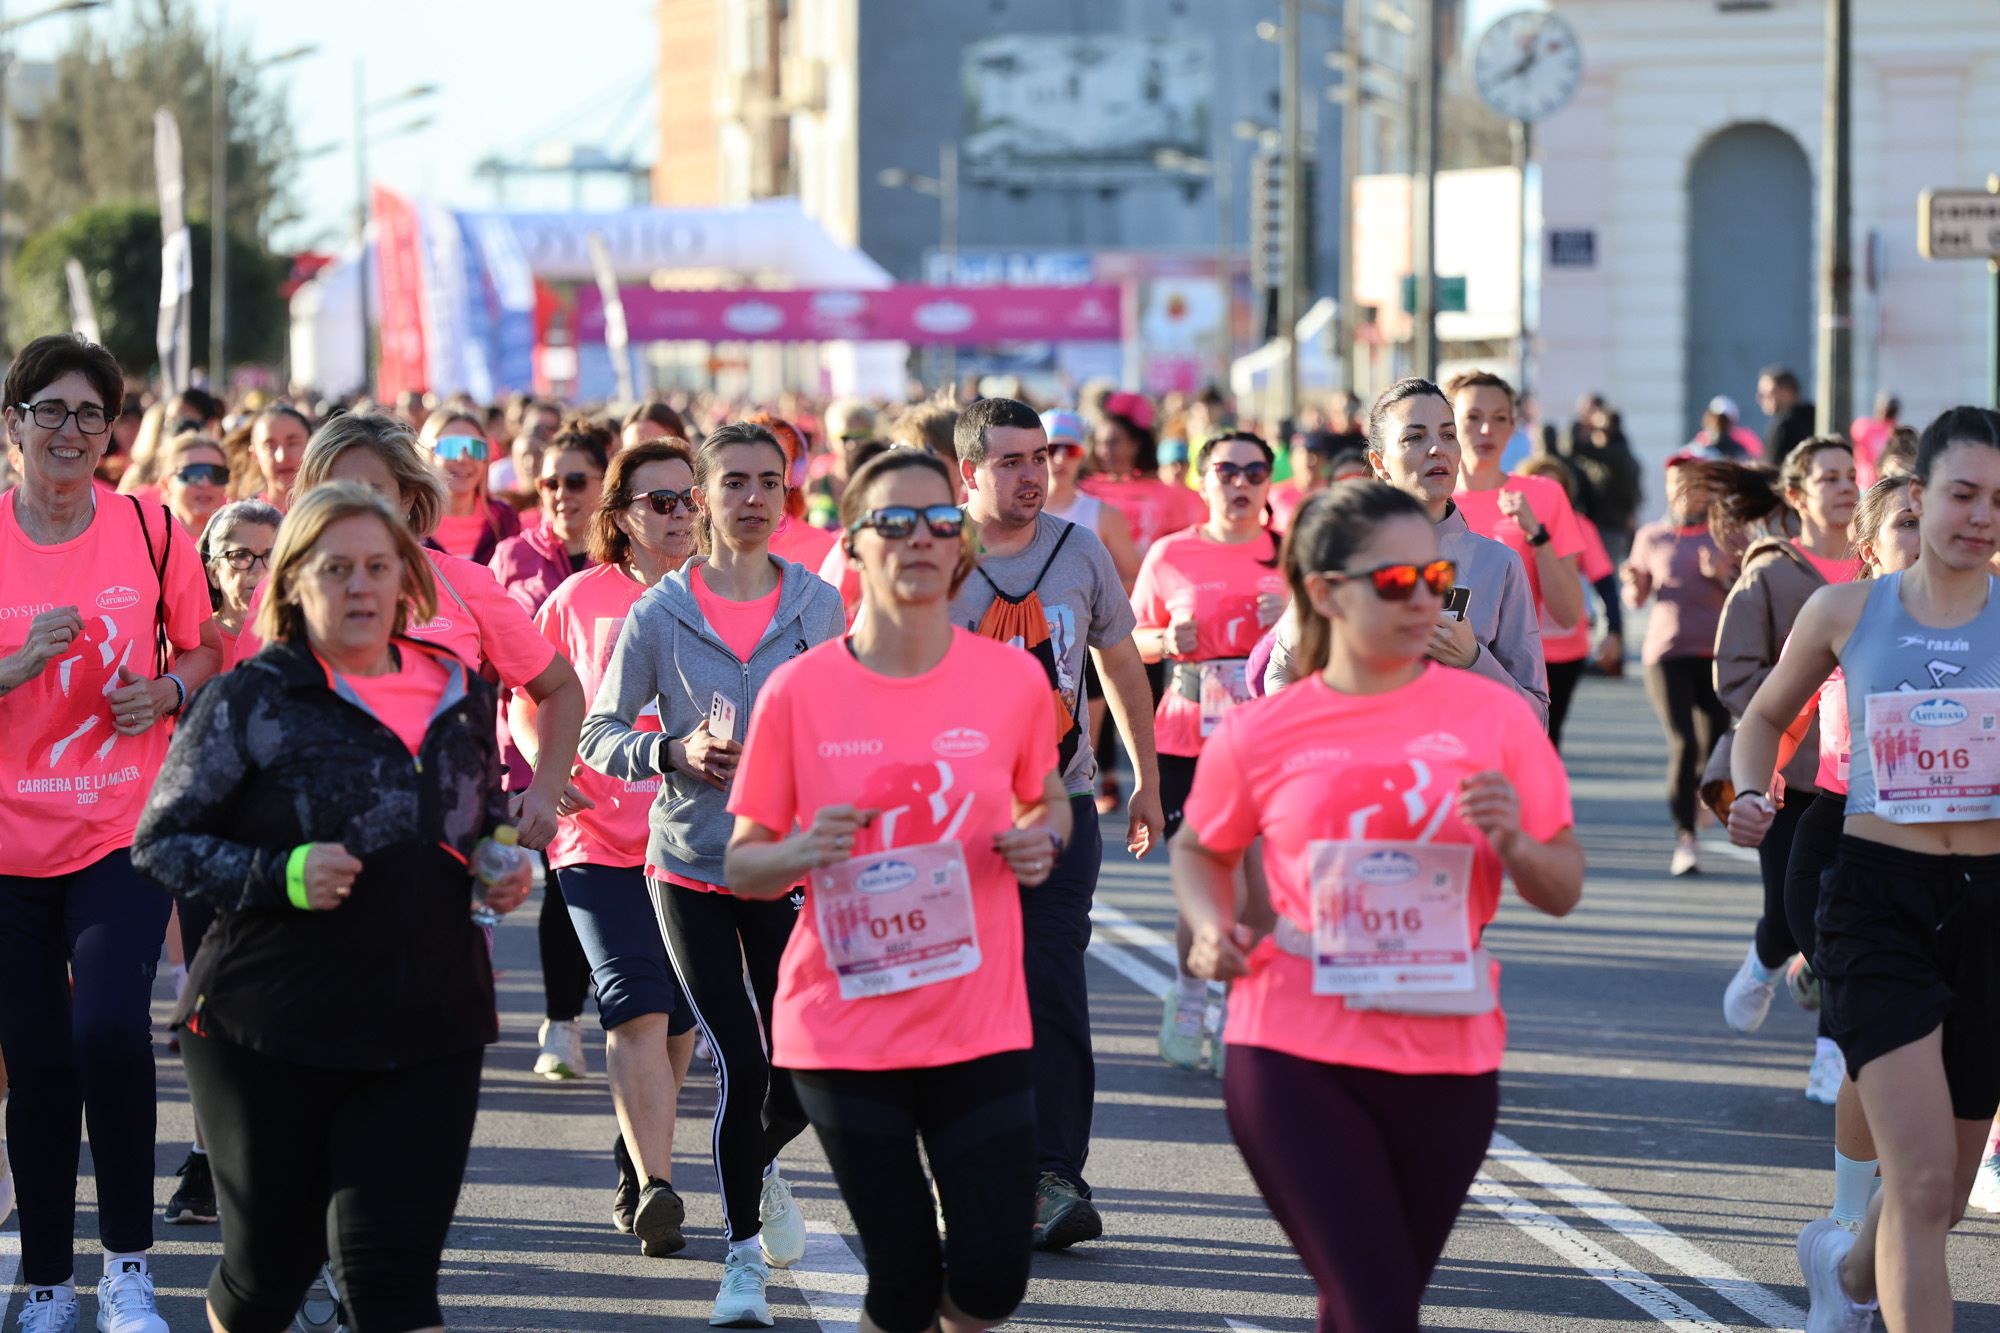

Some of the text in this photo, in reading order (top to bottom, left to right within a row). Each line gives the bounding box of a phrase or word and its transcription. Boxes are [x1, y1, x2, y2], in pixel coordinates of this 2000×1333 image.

[0, 602, 54, 619] OYSHO
[1926, 638, 1970, 652] rasán
[1917, 749, 1969, 770] 016
[17, 778, 72, 793] CARRERA
[74, 775, 91, 791] DE
[1929, 775, 1954, 785] 5412
[77, 792, 98, 804] 2025
[871, 910, 926, 939] 016
[1362, 908, 1422, 933] 016
